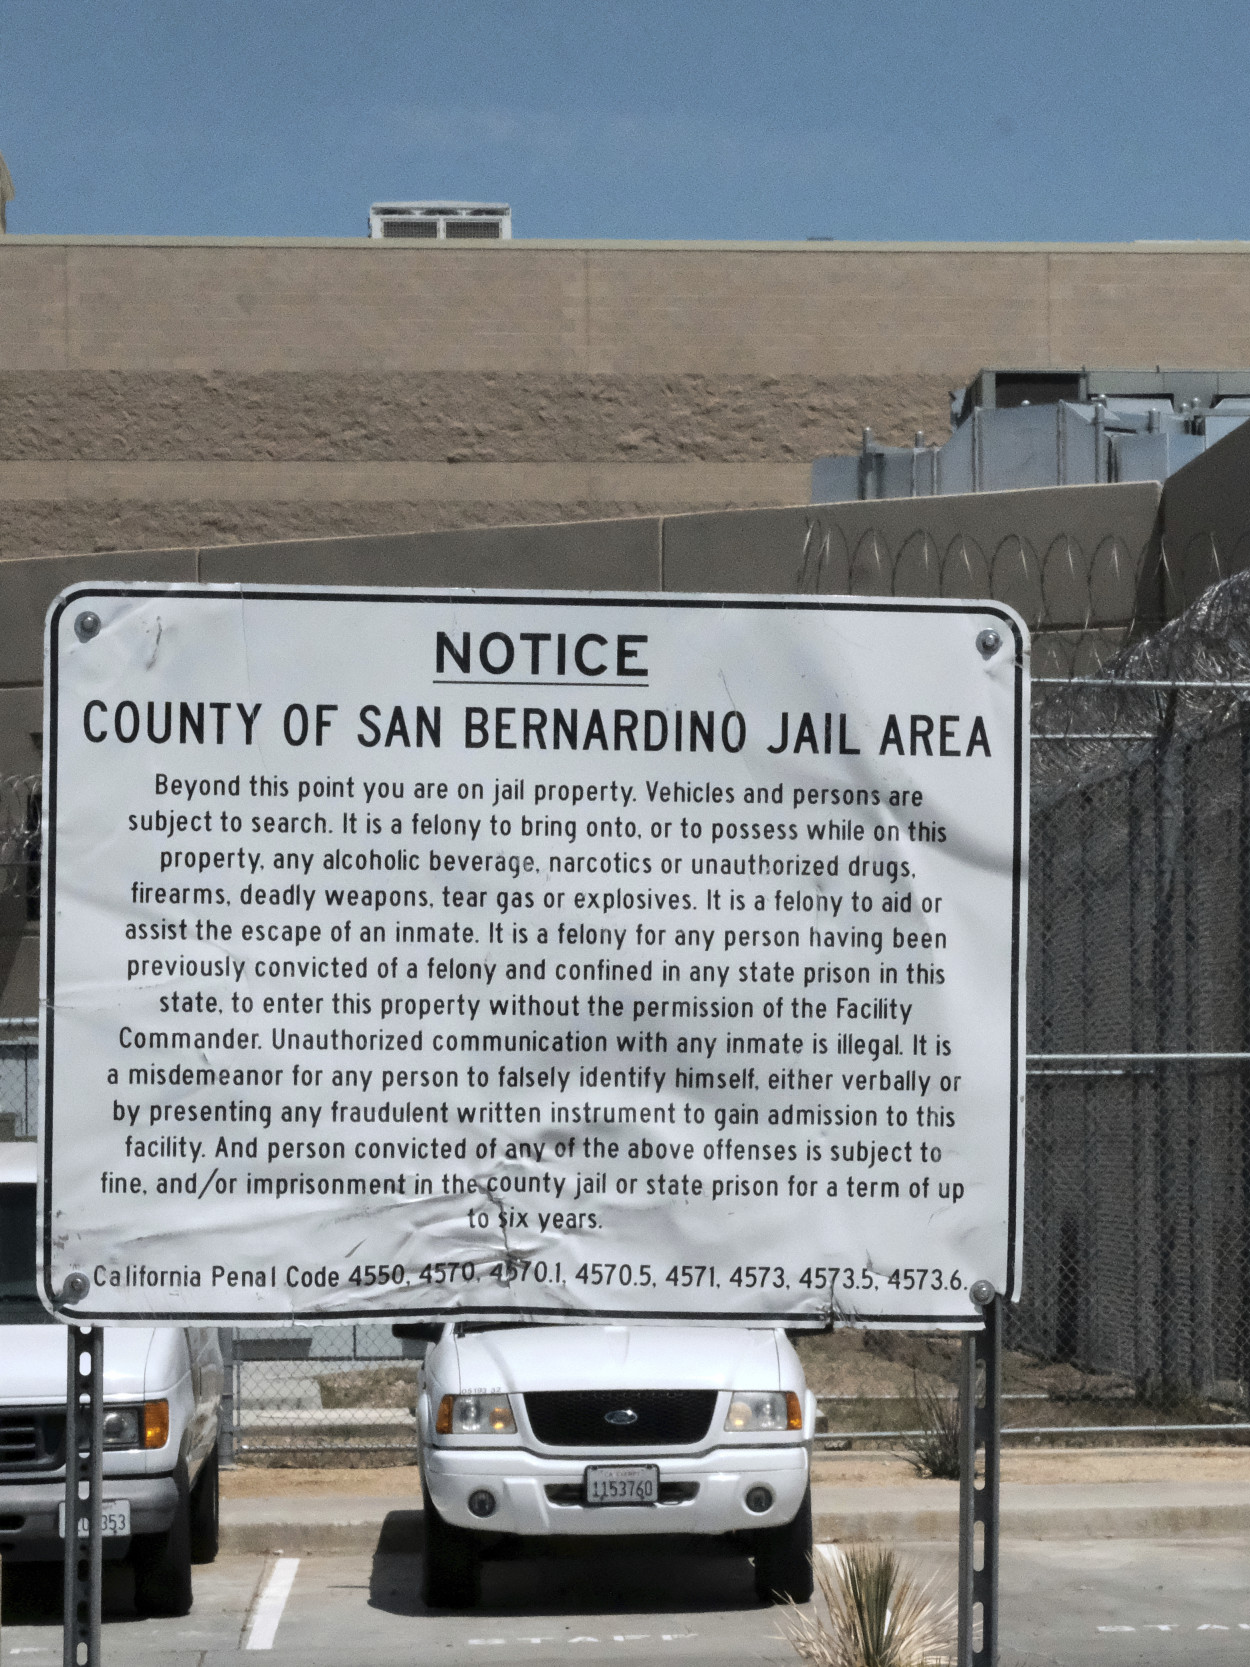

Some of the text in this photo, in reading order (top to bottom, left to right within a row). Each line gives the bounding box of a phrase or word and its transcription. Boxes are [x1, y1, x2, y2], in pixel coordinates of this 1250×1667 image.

[435, 631, 649, 677] NOTICE
[83, 699, 992, 758] COUNTY OF SAN BERNARDINO JAIL AREA
[155, 773, 923, 810] Beyond this point you are on jail property. Vehicles and persons are
[128, 809, 947, 845] subject to search. It is a felony to bring onto, or to possess while on this
[160, 847, 916, 885] property, any alcoholic beverage, narcotics or unauthorized drugs,
[130, 880, 943, 918] firearms, deadly weapons, tear gas or explosives. It is a felony to aid or
[125, 917, 947, 956] assist the escape of an inmate. It is a felony for any person having been
[127, 955, 946, 988] previously convicted of a felony and confined in any state prison in this
[159, 990, 913, 1026] state, to enter this property without the permission of the Facility
[119, 1026, 952, 1063] Commander. Unauthorized communication with any inmate is illegal. It is
[113, 1099, 956, 1132] by presenting any fraudulent written instrument to gain admission to this
[100, 1167, 965, 1204] fine, and/or imprisonment in the county jail or state prison for a term of up
[466, 1204, 603, 1236] to six years.
[93, 1264, 201, 1288] California
[211, 1265, 276, 1288] Penal
[286, 1264, 340, 1289] Code
[348, 1264, 411, 1288] 4550,
[418, 1261, 481, 1284] 4570,
[574, 1262, 657, 1289] 4570.5,
[665, 1265, 721, 1289] 4571,
[729, 1266, 791, 1290] 4573,
[798, 1266, 882, 1292] 4573.5,
[886, 1268, 968, 1291] 4573.6.
[592, 1480, 653, 1499] 1153760
